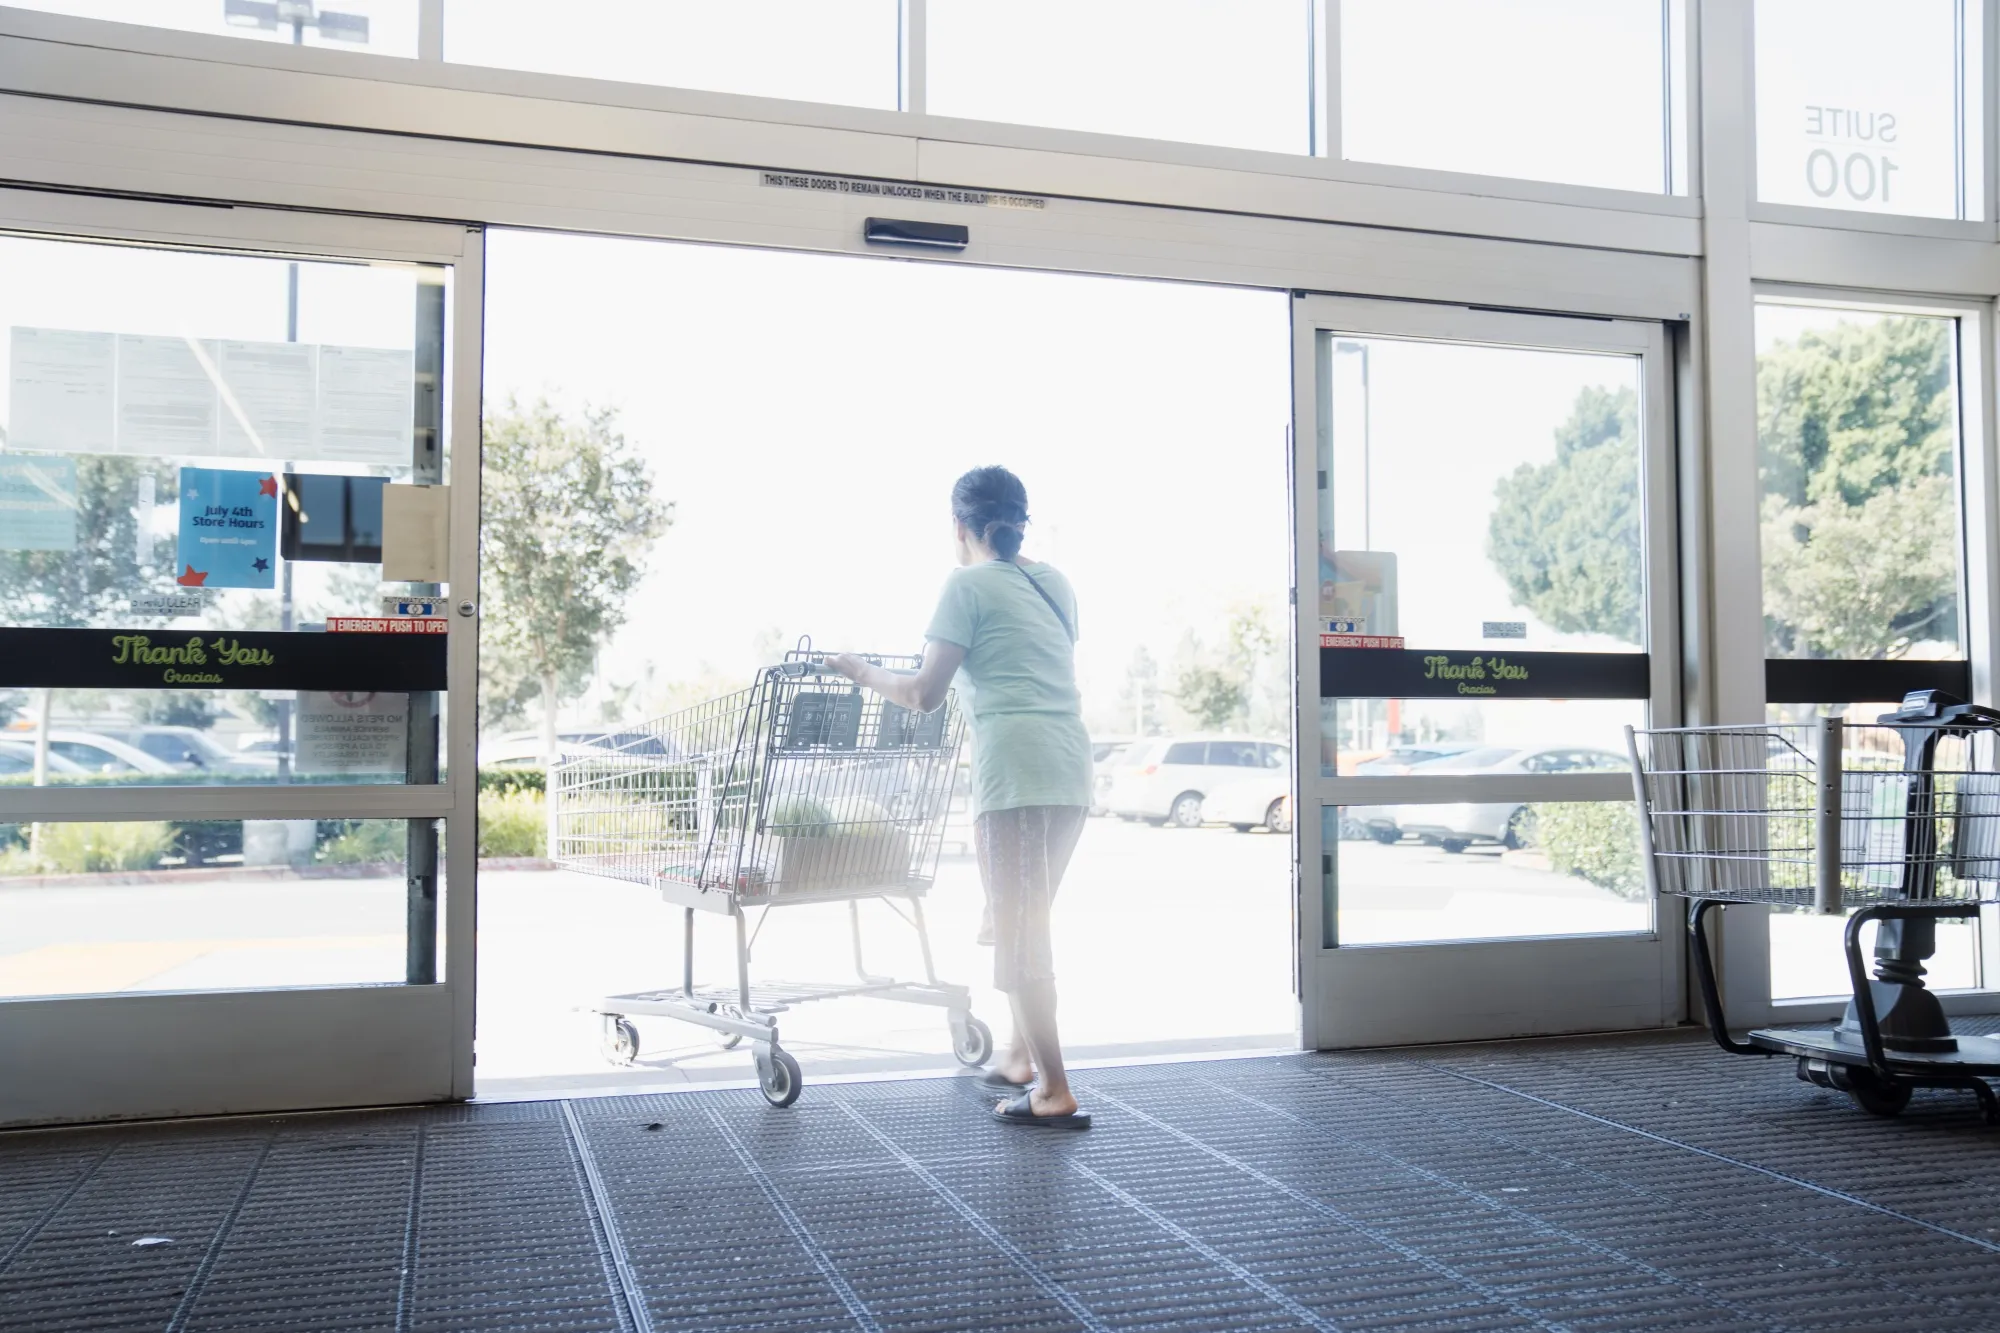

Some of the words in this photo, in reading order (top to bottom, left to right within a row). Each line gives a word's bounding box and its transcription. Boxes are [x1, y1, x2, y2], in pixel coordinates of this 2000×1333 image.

[811, 178, 837, 191] DOORS
[839, 181, 849, 192] TO
[851, 182, 880, 195] REMAIN
[882, 185, 922, 199] UNLOCKED
[924, 189, 946, 201] WHEN
[948, 191, 962, 202] THE
[964, 192, 998, 206] BUILDING
[1009, 196, 1046, 210] OCCUPIED
[205, 505, 229, 518] July
[232, 506, 253, 517] 4th
[192, 516, 225, 527] Store
[228, 518, 265, 529] Hours
[383, 596, 425, 604] AUTOMATIC
[427, 597, 448, 605] DOOR
[328, 619, 336, 633] IN
[338, 620, 388, 633] EMERGENCY
[389, 620, 412, 634] PUSH
[413, 621, 425, 634] TO
[426, 621, 448, 635] OPEN
[1325, 636, 1361, 649] EMERGENCY
[1363, 637, 1380, 649] PUSH
[1381, 638, 1389, 649] TO
[112, 635, 207, 664] Thank
[210, 637, 274, 665] You
[1424, 655, 1486, 680] Thank
[1487, 657, 1528, 680] You
[163, 668, 224, 684] Gracias
[1457, 682, 1497, 694] Gracias
